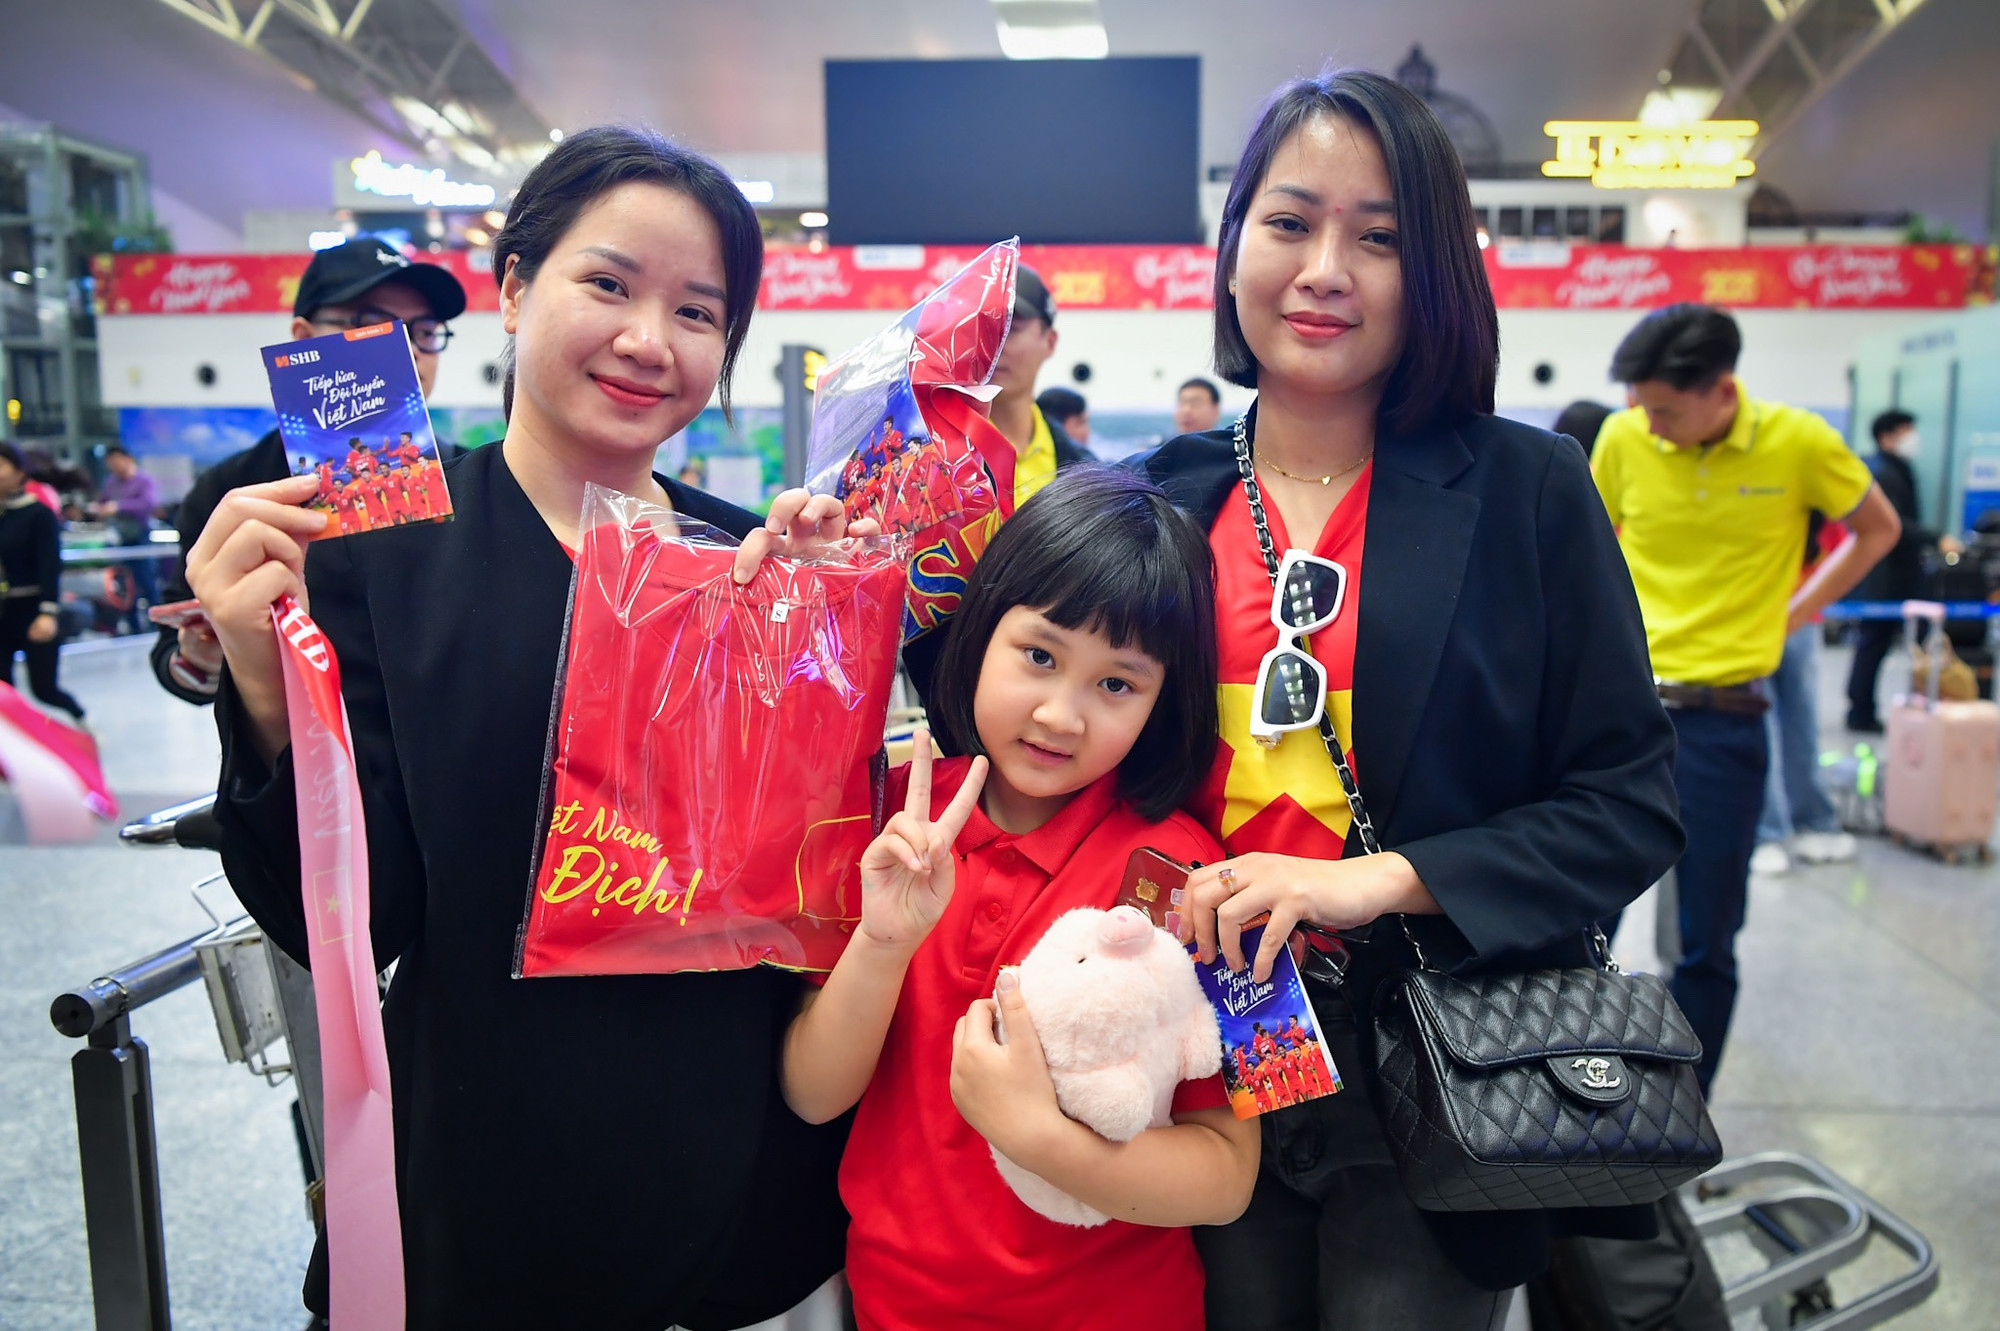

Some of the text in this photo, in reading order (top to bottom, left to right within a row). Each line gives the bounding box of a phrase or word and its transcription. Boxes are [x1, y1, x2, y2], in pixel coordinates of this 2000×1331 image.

[289, 350, 321, 366] SHB
[303, 374, 333, 396] Tiếp
[329, 375, 386, 404] Đội tuyển
[312, 396, 386, 430] Việt Nam
[774, 608, 784, 620] S
[548, 799, 664, 854] ệt Nam
[540, 845, 703, 926] Địch!
[1212, 965, 1234, 987] Tiếp
[1232, 976, 1249, 993] Đội
[1222, 982, 1274, 1017] Việt Nam
